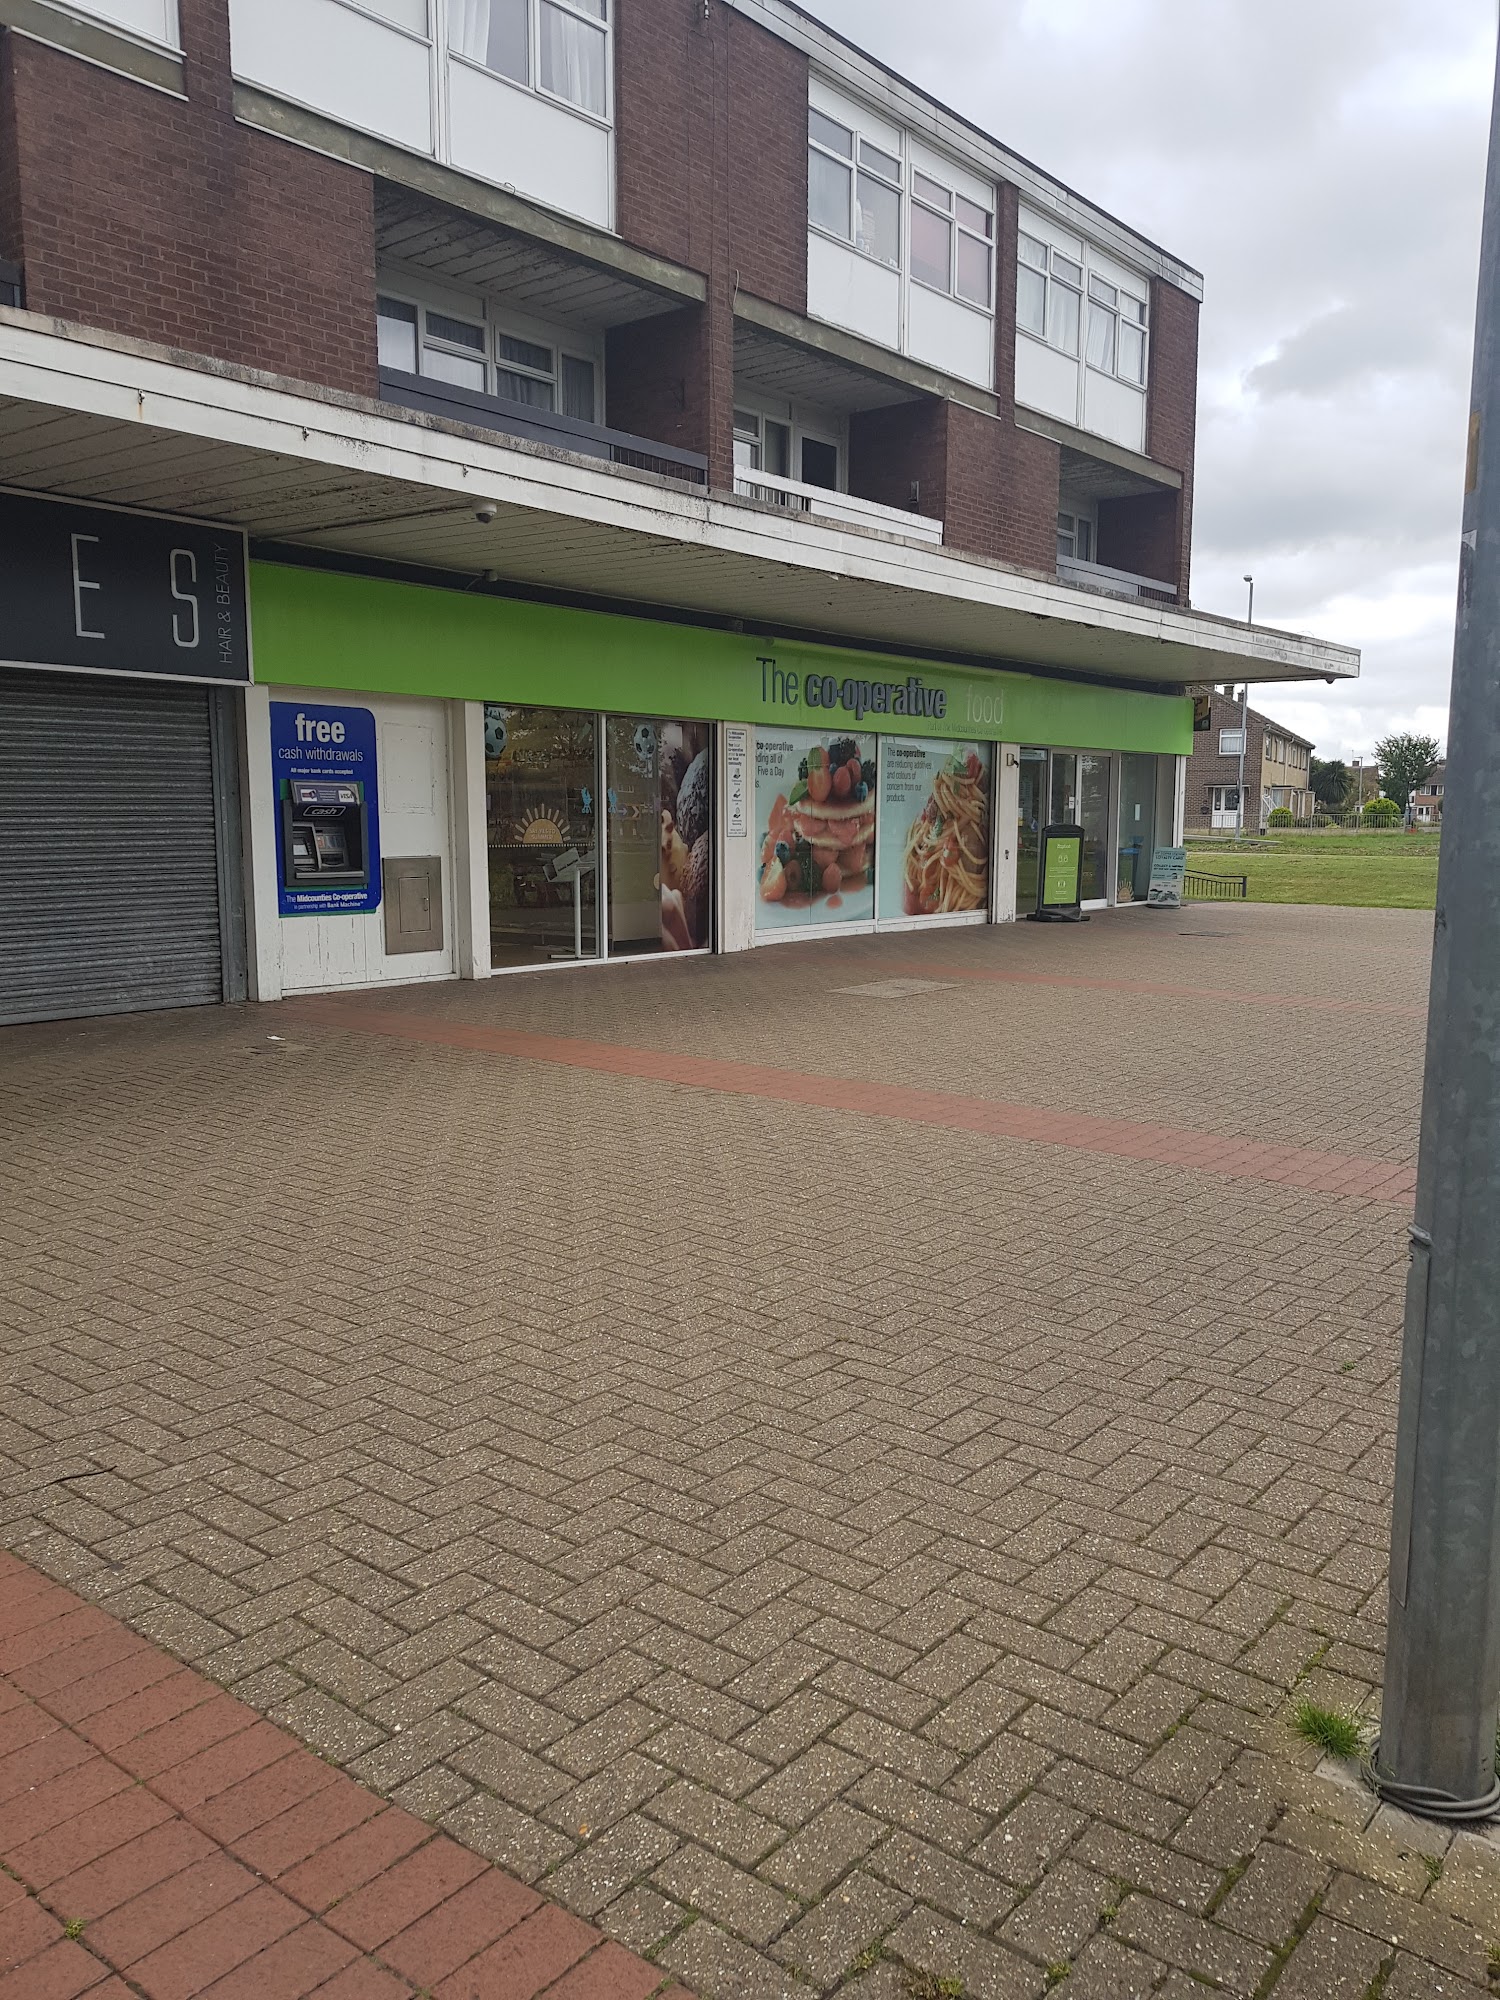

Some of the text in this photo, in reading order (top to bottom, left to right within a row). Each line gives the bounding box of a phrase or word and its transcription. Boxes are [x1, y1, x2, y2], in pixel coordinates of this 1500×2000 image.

[214, 543, 233, 664] HAIR & BEAUTY
[755, 656, 1004, 725] The co-operative food
[294, 712, 346, 744] free
[278, 745, 364, 762] cash withdrawals
[769, 752, 777, 764] all
[887, 747, 926, 759] The co-operative
[757, 765, 769, 776] Five
[774, 766, 784, 778] Day
[894, 760, 914, 771] reducing
[914, 761, 932, 770] additives
[886, 770, 895, 780] and
[895, 771, 912, 780] colours
[904, 782, 915, 791] from
[311, 807, 338, 815] cash
[286, 892, 368, 903] The Midcounties Co-operative
